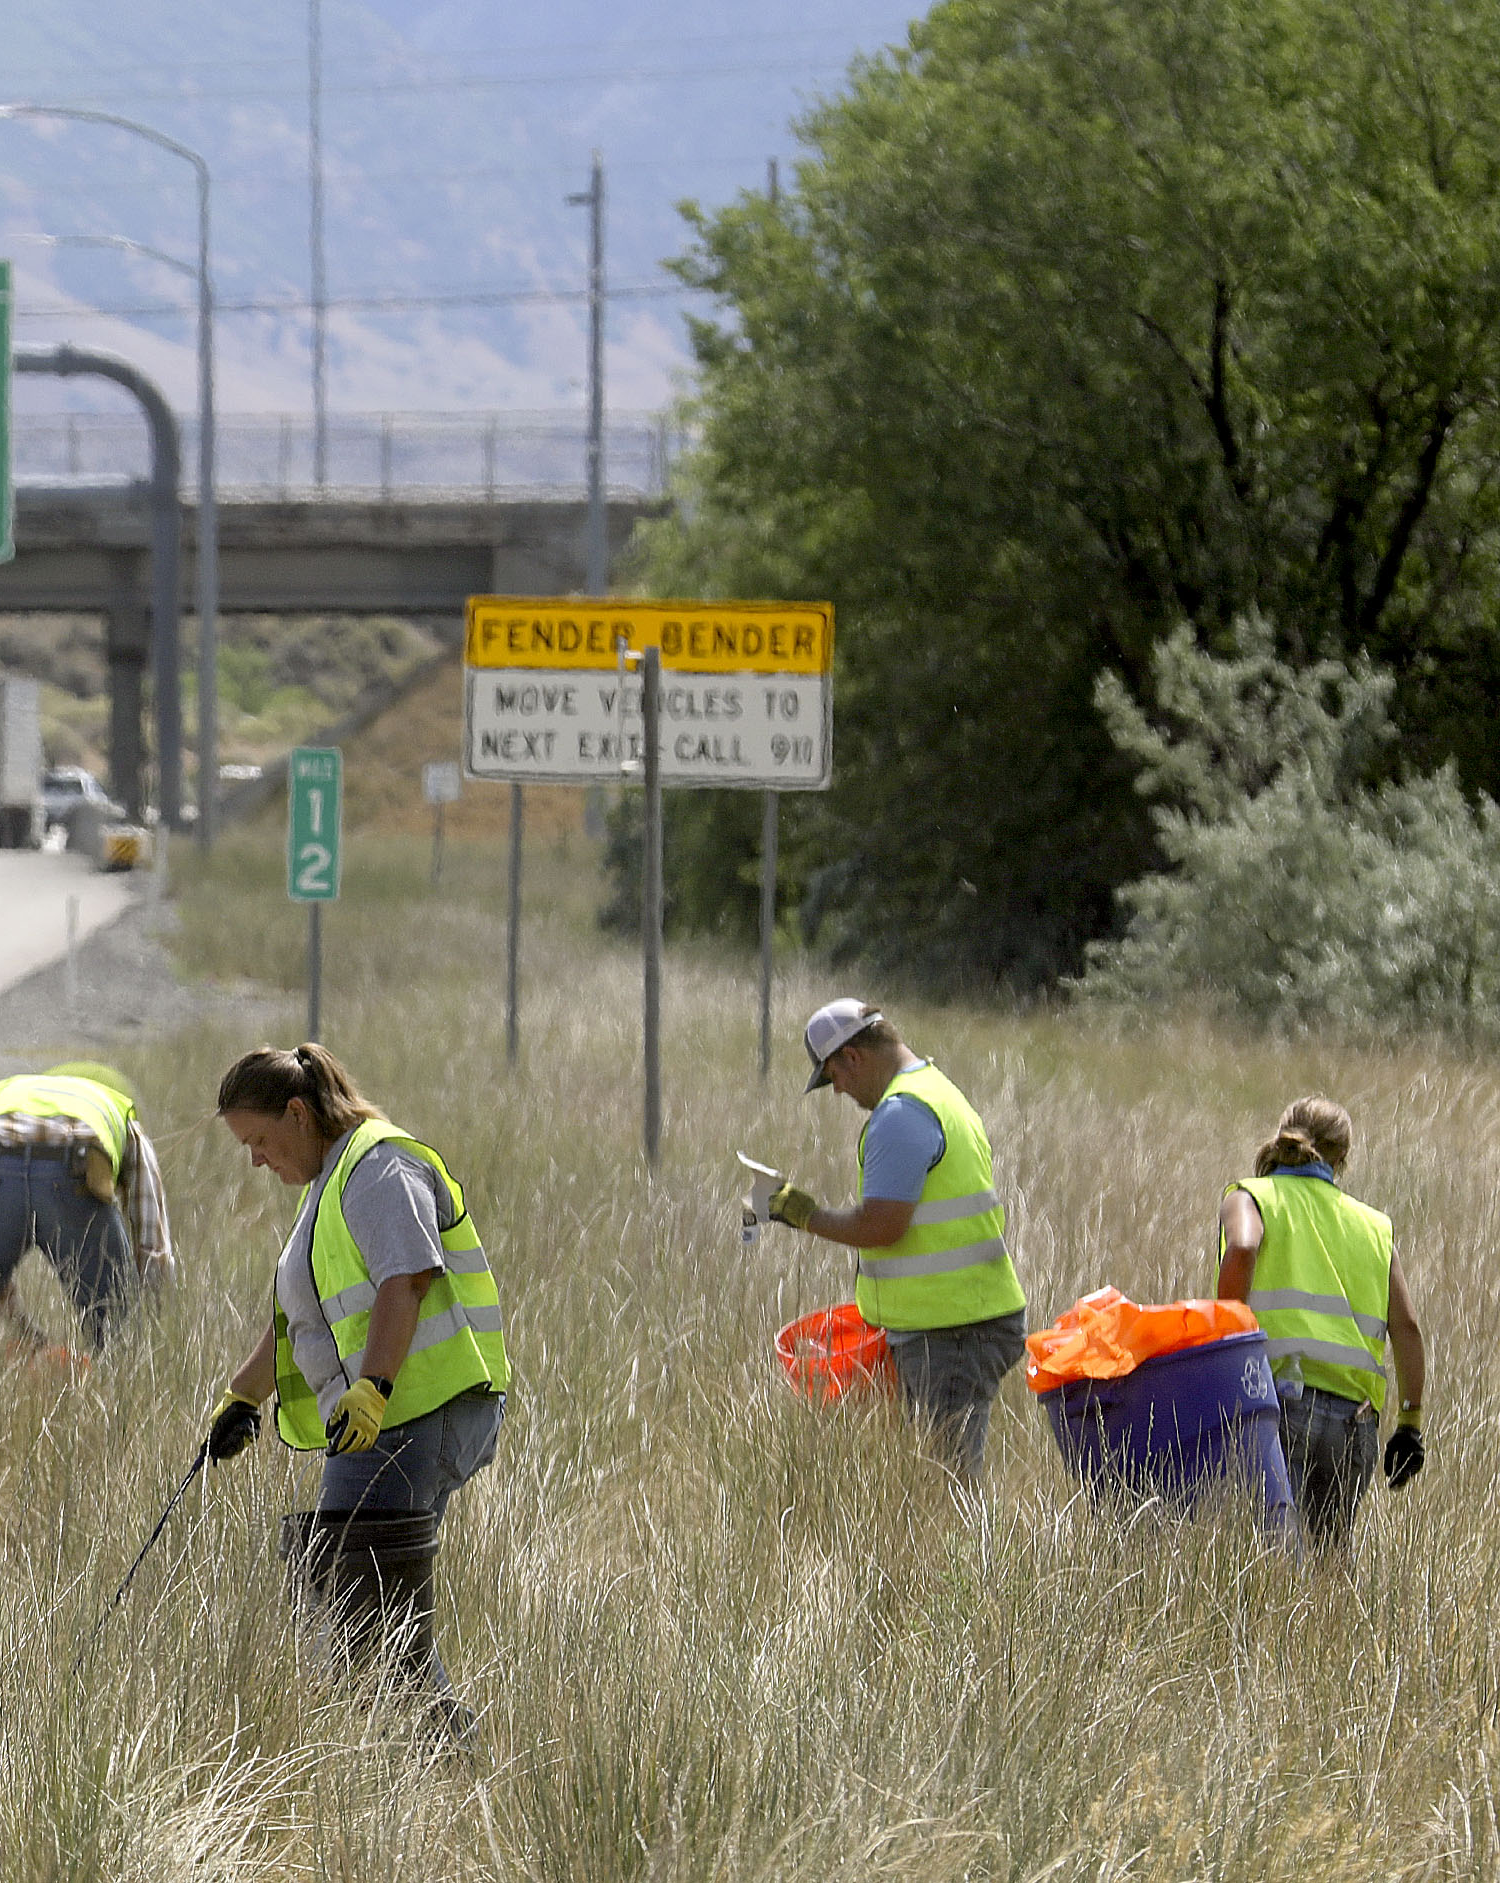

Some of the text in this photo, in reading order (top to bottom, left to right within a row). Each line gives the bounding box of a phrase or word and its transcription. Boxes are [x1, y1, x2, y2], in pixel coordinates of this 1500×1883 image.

[661, 621, 817, 659] BENDER
[496, 684, 799, 722] MOVE VEICLES TO
[481, 729, 557, 762] NEXT
[674, 733, 750, 766] CALL
[770, 733, 814, 765] 911
